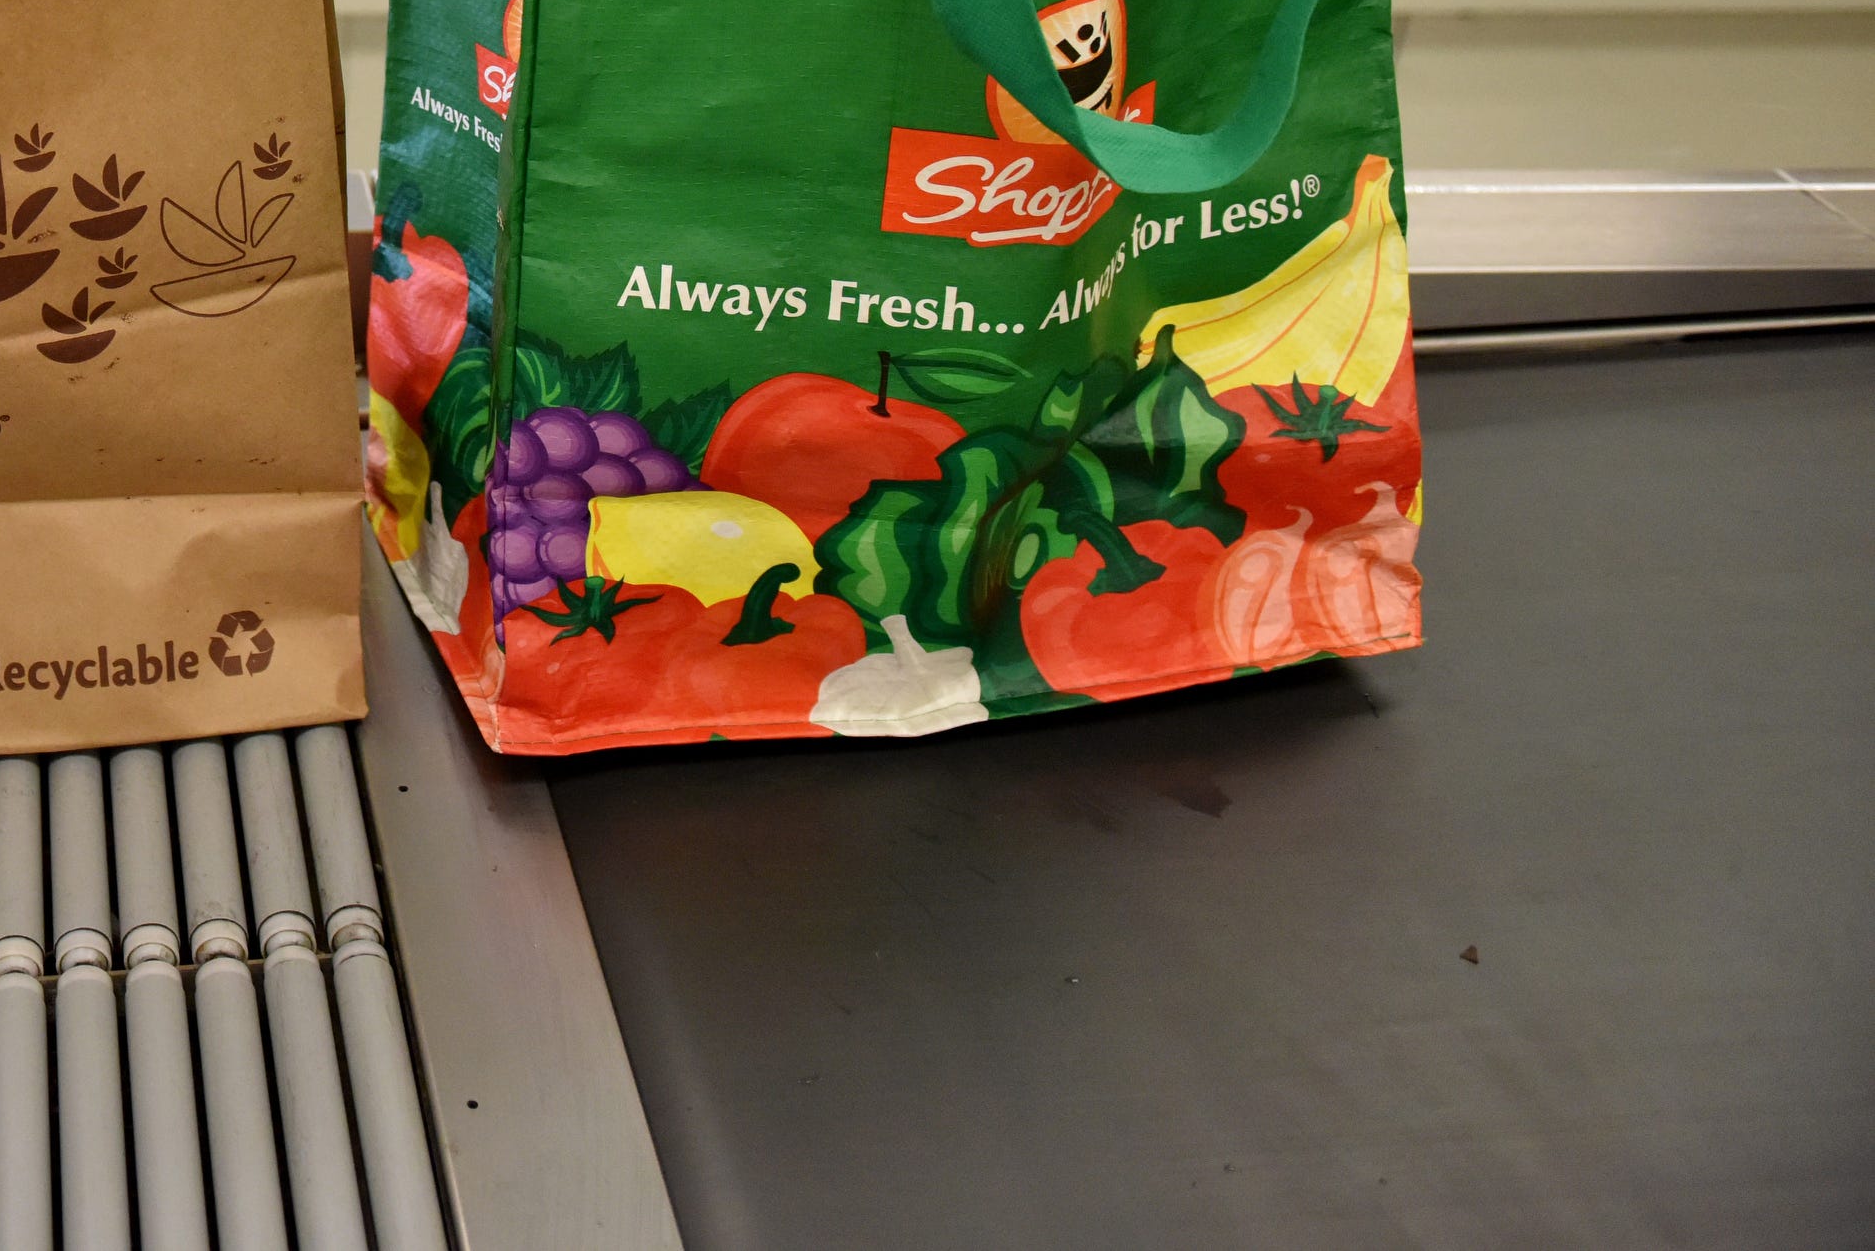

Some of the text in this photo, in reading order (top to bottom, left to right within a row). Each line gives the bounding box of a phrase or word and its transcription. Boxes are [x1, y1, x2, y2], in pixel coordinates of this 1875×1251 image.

[410, 86, 503, 153] Always Fres
[615, 264, 807, 332] Always
[827, 279, 1025, 334] Fresh...
[1038, 242, 1126, 330] Always
[1132, 213, 1185, 258] for
